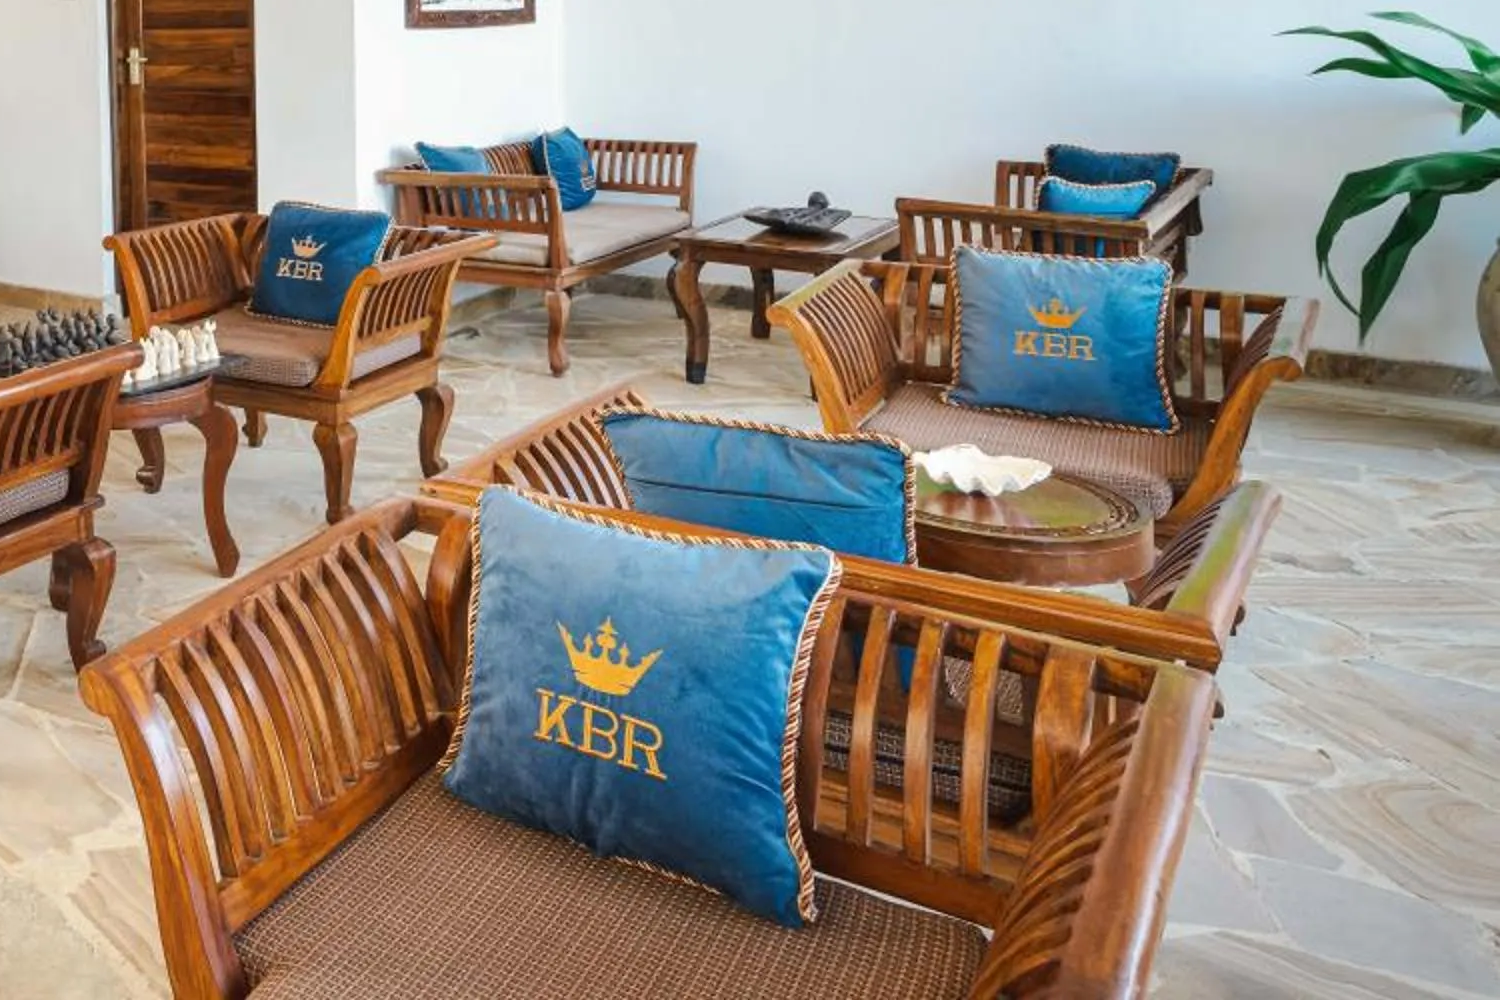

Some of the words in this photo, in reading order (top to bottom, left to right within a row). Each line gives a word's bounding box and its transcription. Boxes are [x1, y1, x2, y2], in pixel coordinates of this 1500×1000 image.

[276, 257, 324, 281] KBR
[1013, 331, 1097, 360] KBR
[534, 688, 667, 781] KBR
